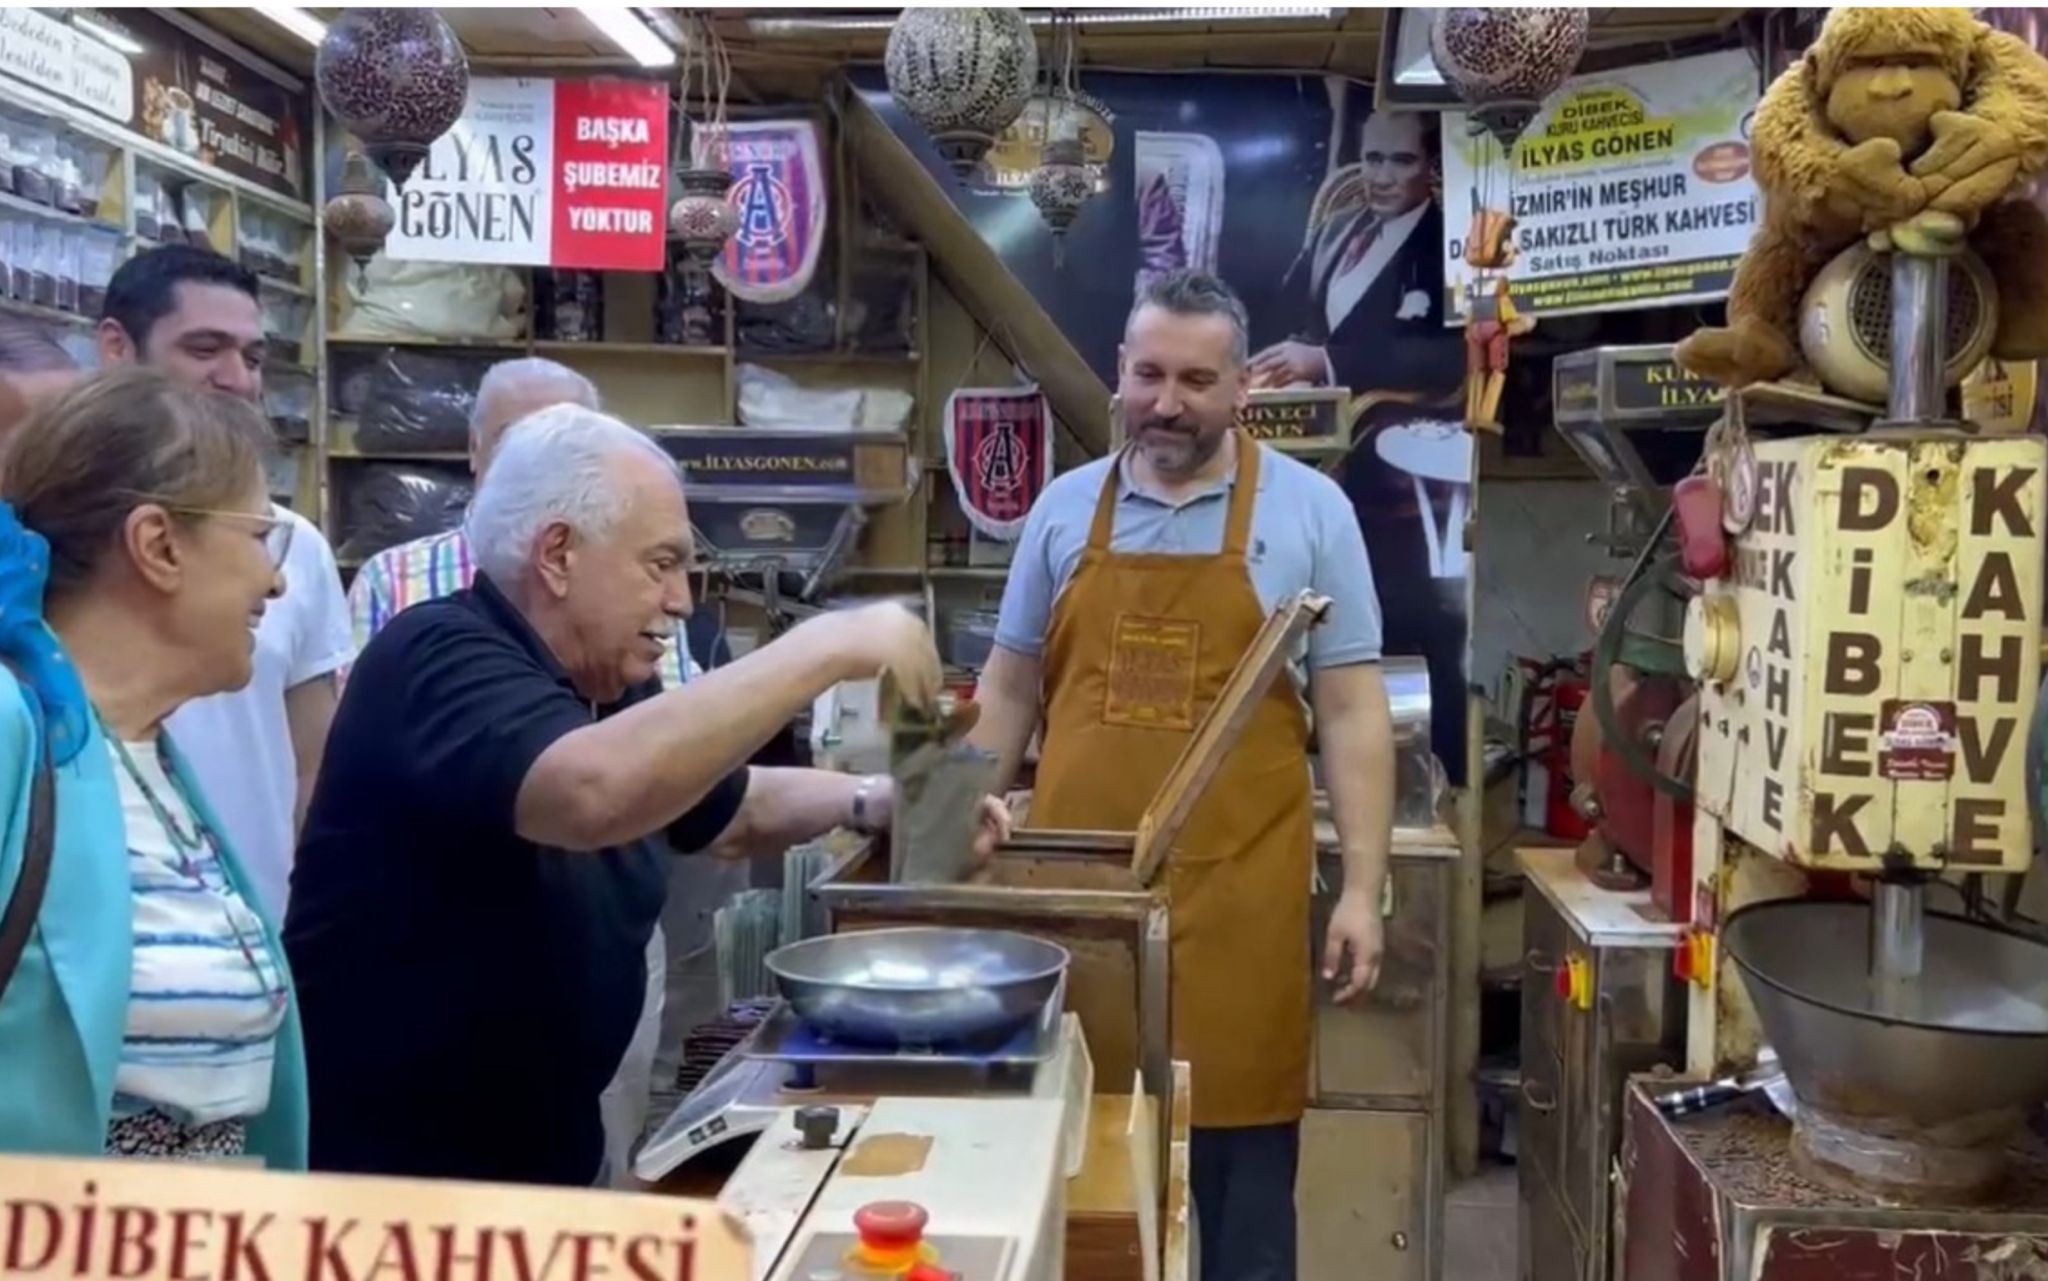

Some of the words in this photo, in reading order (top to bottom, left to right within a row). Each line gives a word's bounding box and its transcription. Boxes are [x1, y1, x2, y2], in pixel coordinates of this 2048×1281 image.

[1562, 99, 1630, 119] DİBEK
[576, 116, 648, 149] BAŞKA
[422, 132, 536, 185] LYAS
[1521, 140, 1585, 170] İLYAS
[563, 159, 661, 195] ŞUBEMİZ
[1599, 173, 1688, 209] MEŞHUR
[567, 206, 654, 235] YOKTUR
[1520, 221, 1598, 252] SAKIZLI
[1602, 209, 1660, 241] TÜRK
[1665, 195, 1757, 232] KAHVESİ
[1530, 253, 1583, 273] Satış
[1588, 243, 1672, 267] Noktası
[1948, 466, 2037, 867] KAHVE
[1762, 549, 1797, 833] KAHVE
[2, 1180, 279, 1281] DİBEK
